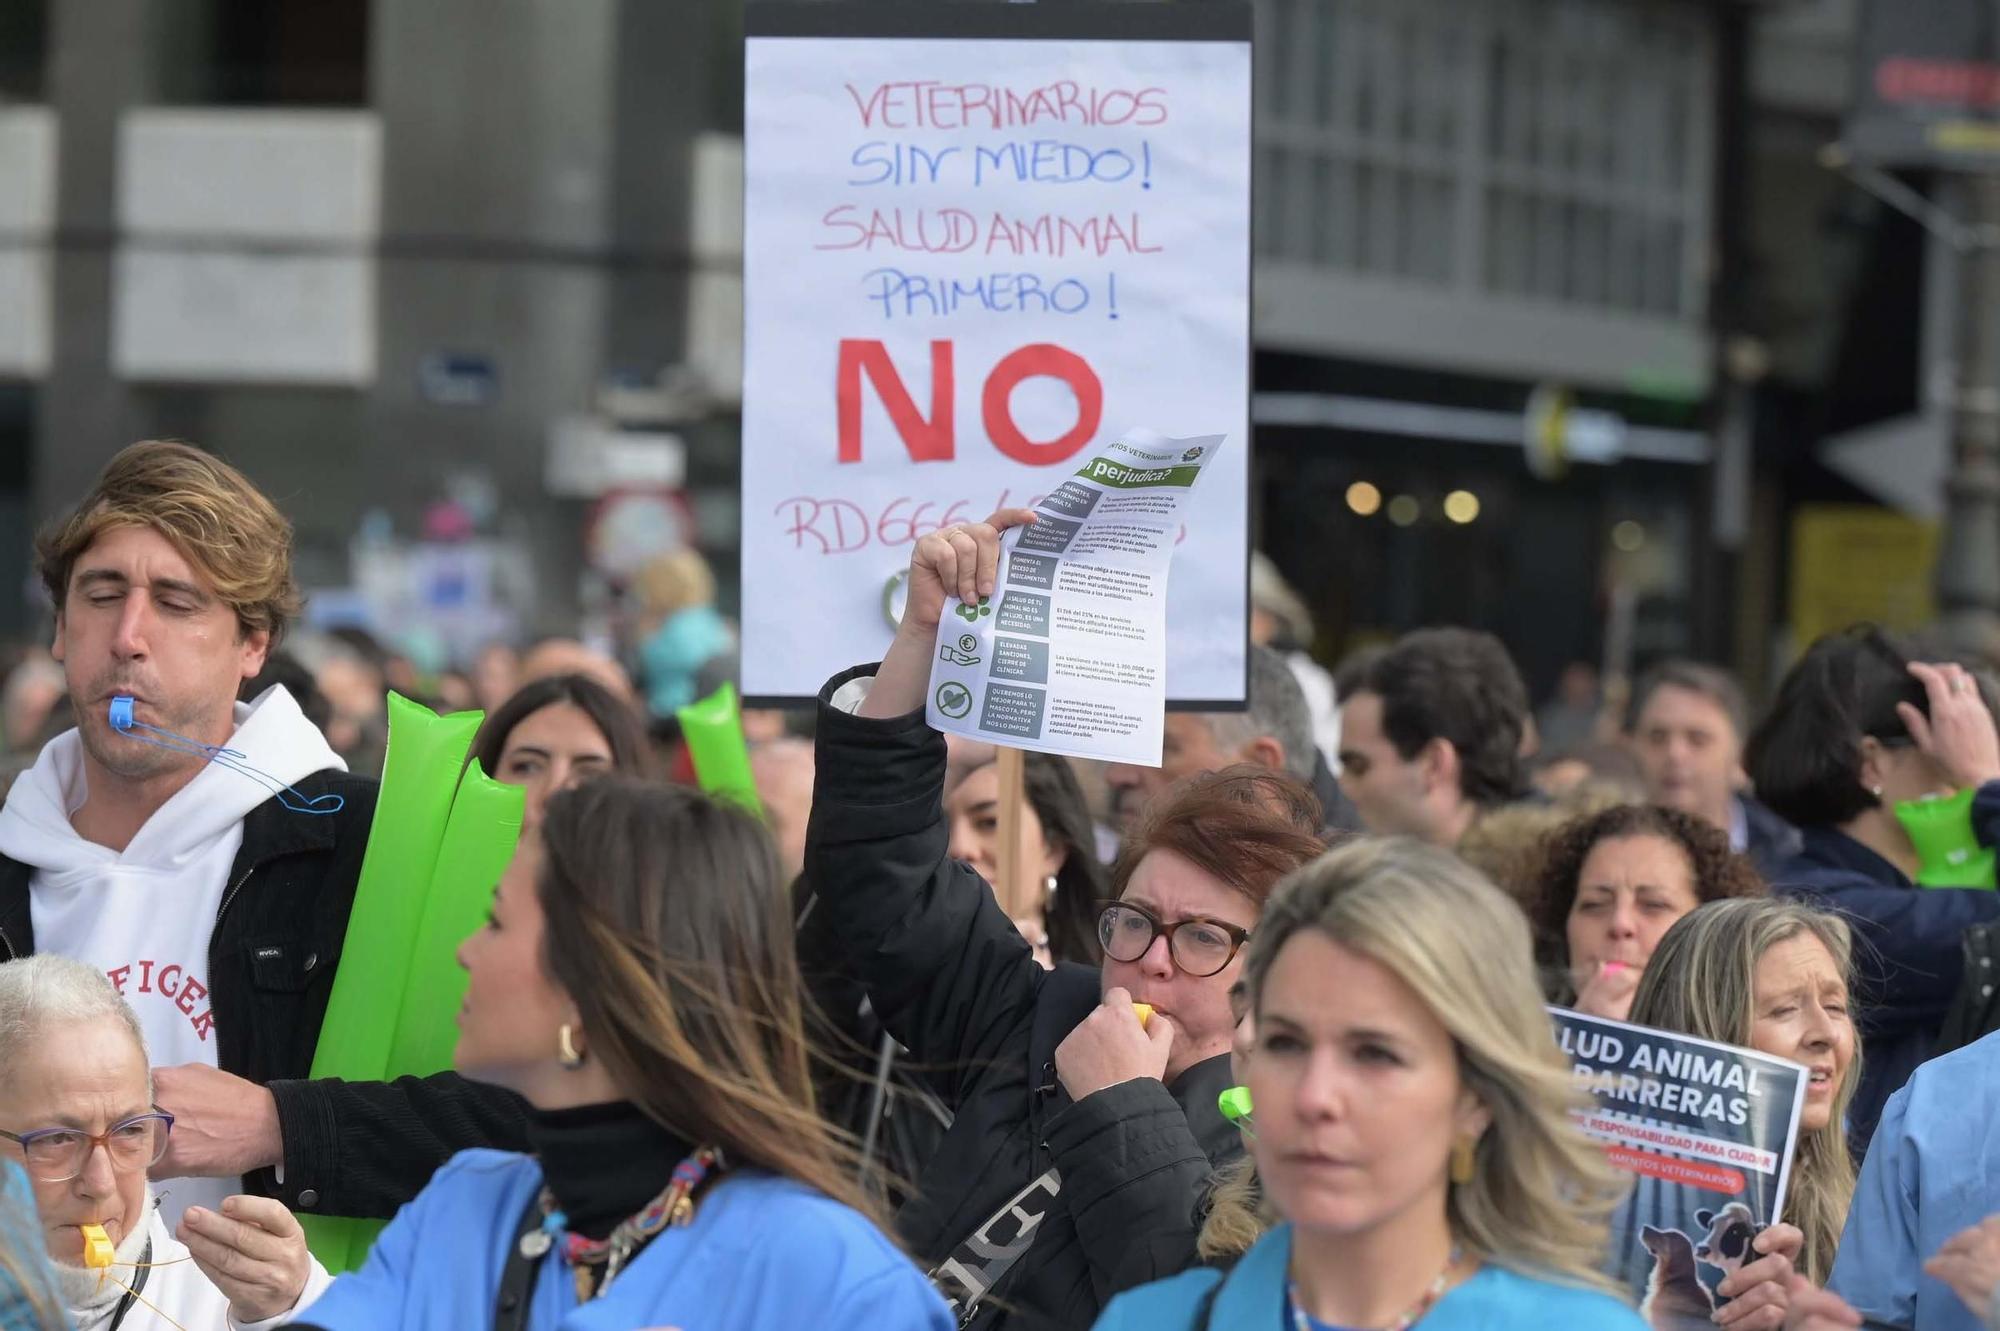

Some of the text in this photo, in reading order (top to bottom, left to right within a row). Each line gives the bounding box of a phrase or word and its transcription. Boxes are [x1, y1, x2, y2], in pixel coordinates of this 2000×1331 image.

[845, 80, 1168, 130] VETERINARIOS
[848, 139, 1151, 190] SIN MIEDO!
[814, 204, 978, 253] SALUD
[837, 339, 1104, 468] NO
[1093, 461, 1172, 484] perjudica?
[258, 949, 280, 957] RVCA
[1558, 1027, 1763, 1097] LUD ANIMAL
[1590, 1118, 1692, 1150] RESPONSABILIDAD
[1695, 1141, 1726, 1158] PARA
[1727, 1148, 1771, 1170] CUIDAR
[1608, 1150, 1738, 1188] AMENTOS VETERINARIOS
